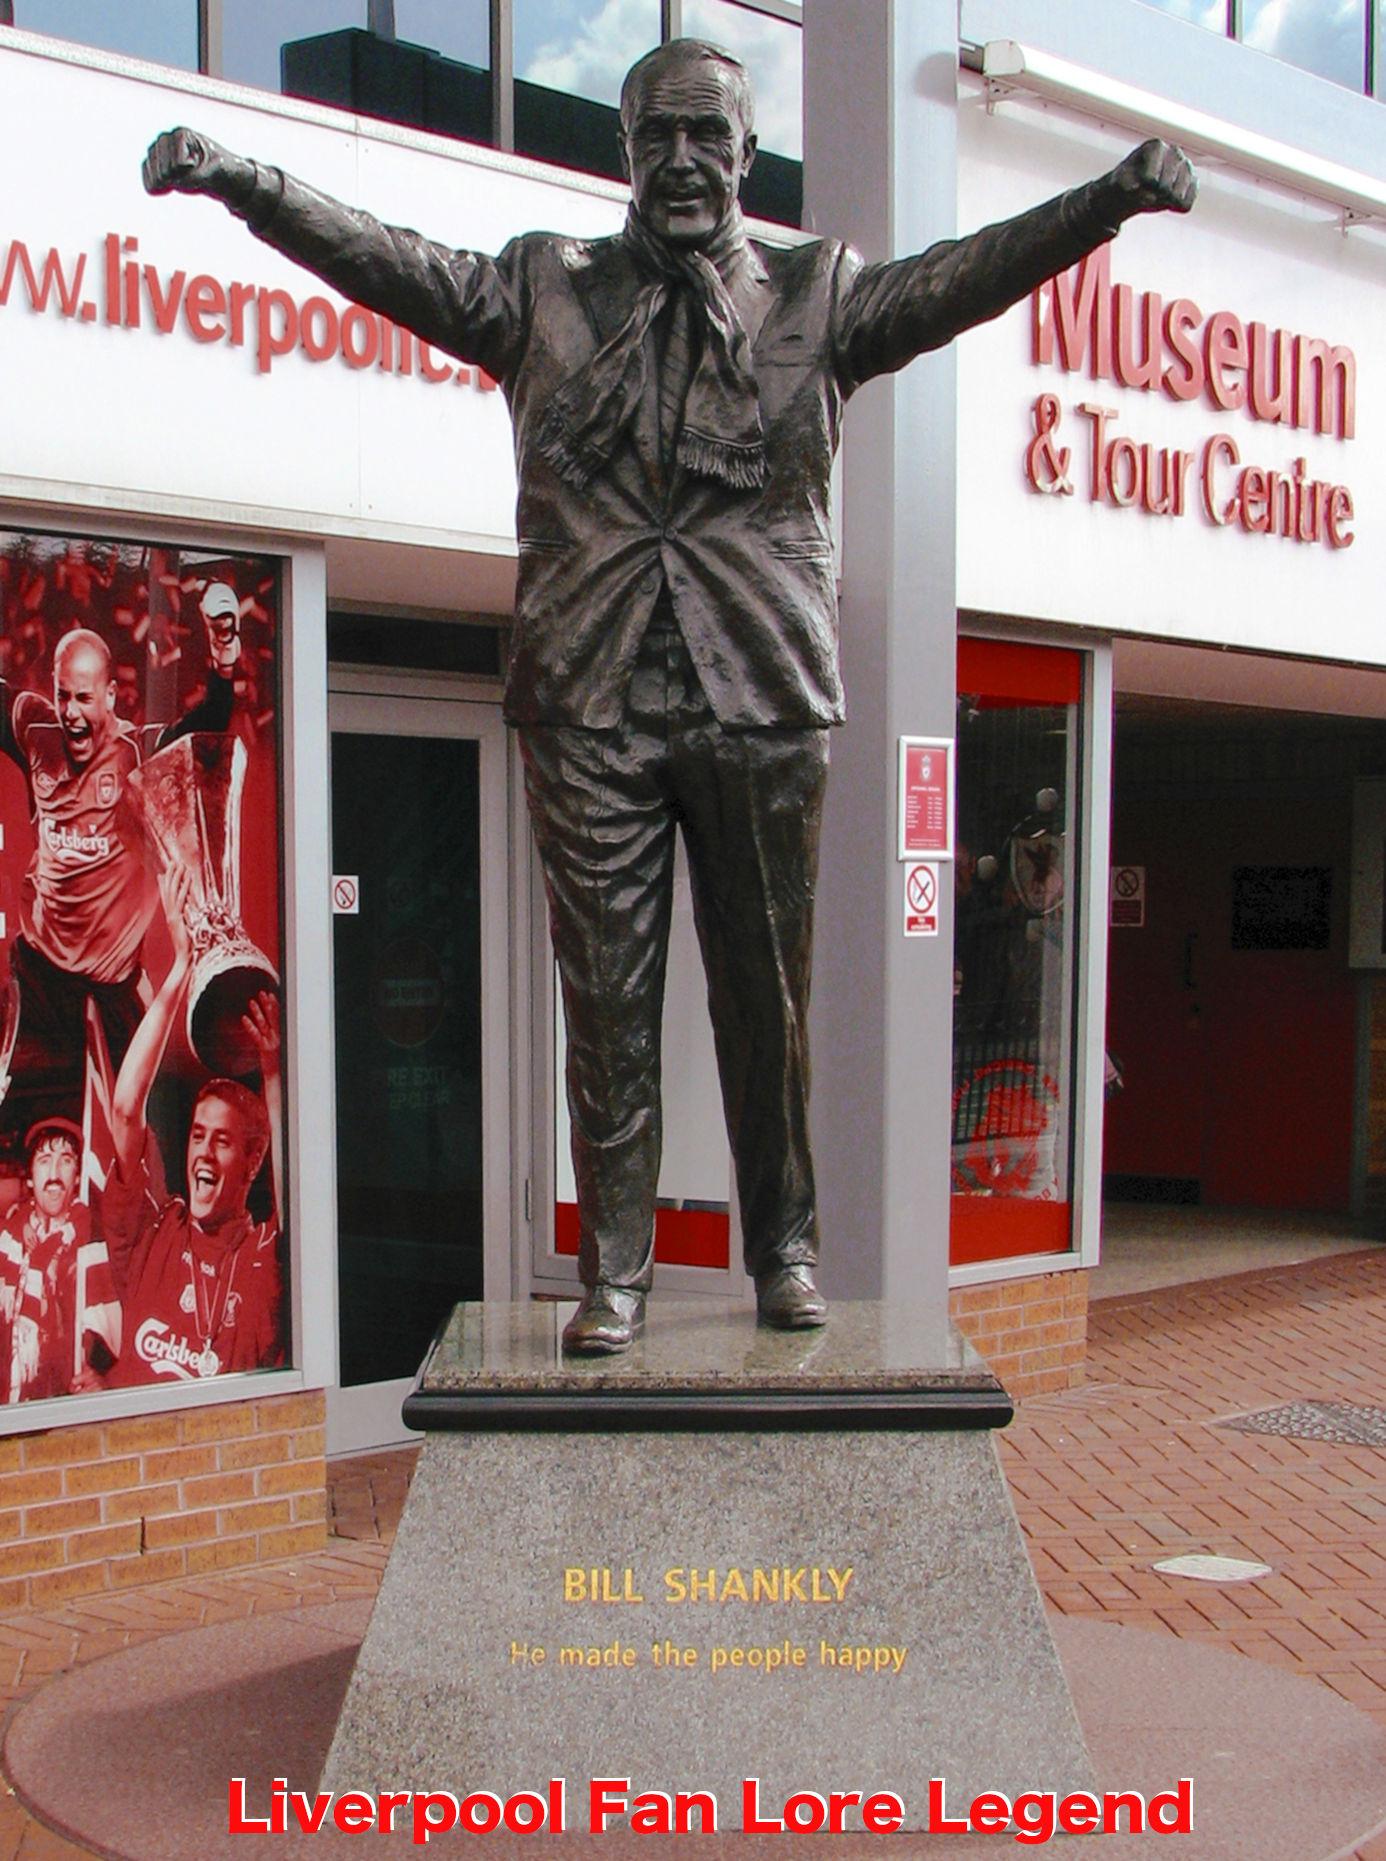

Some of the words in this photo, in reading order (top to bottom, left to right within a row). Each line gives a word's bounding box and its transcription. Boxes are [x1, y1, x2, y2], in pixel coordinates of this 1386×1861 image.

[1032, 243, 1357, 440] Museum
[1026, 393, 1073, 495] &
[1075, 402, 1194, 517] Tour
[1201, 433, 1355, 550] Centre
[39, 818, 110, 857] Carlsberg
[134, 1317, 222, 1370] Carlsbe
[563, 1567, 643, 1602] BILL
[664, 1566, 854, 1603] SHANKLY
[509, 1641, 546, 1667] He
[560, 1641, 637, 1667] made
[651, 1641, 697, 1667] the
[711, 1641, 807, 1673] people
[820, 1639, 908, 1673] happy
